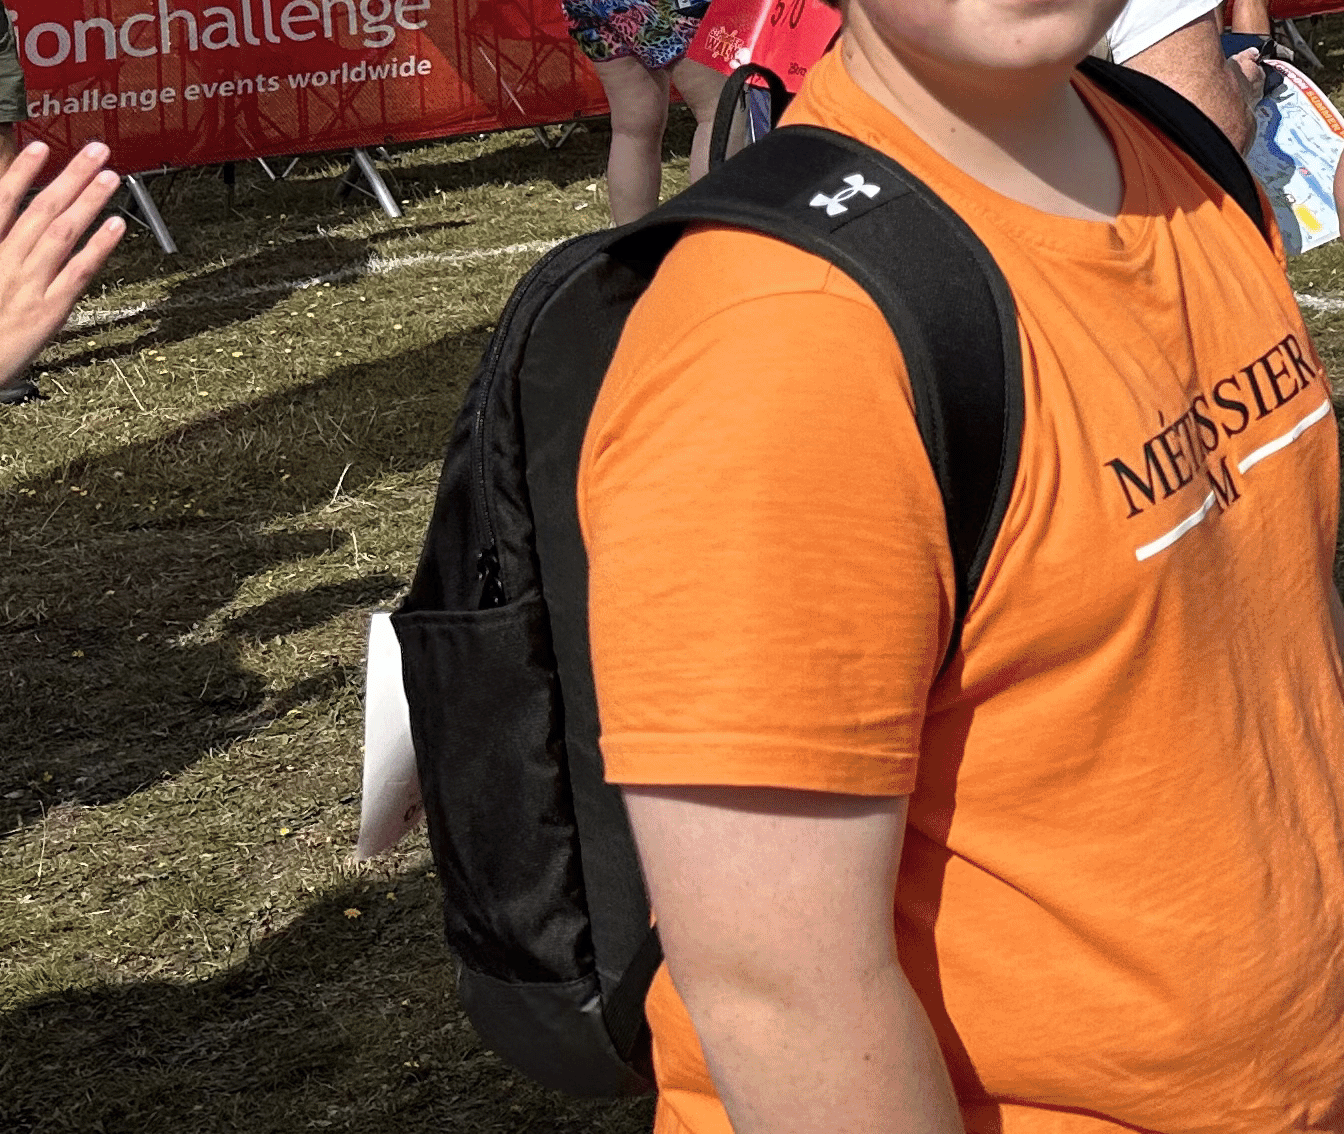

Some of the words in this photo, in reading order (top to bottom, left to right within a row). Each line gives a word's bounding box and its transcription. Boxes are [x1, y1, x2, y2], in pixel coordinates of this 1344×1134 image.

[27, 85, 176, 119] challenge
[184, 75, 280, 100] events
[288, 56, 432, 89] worldwide
